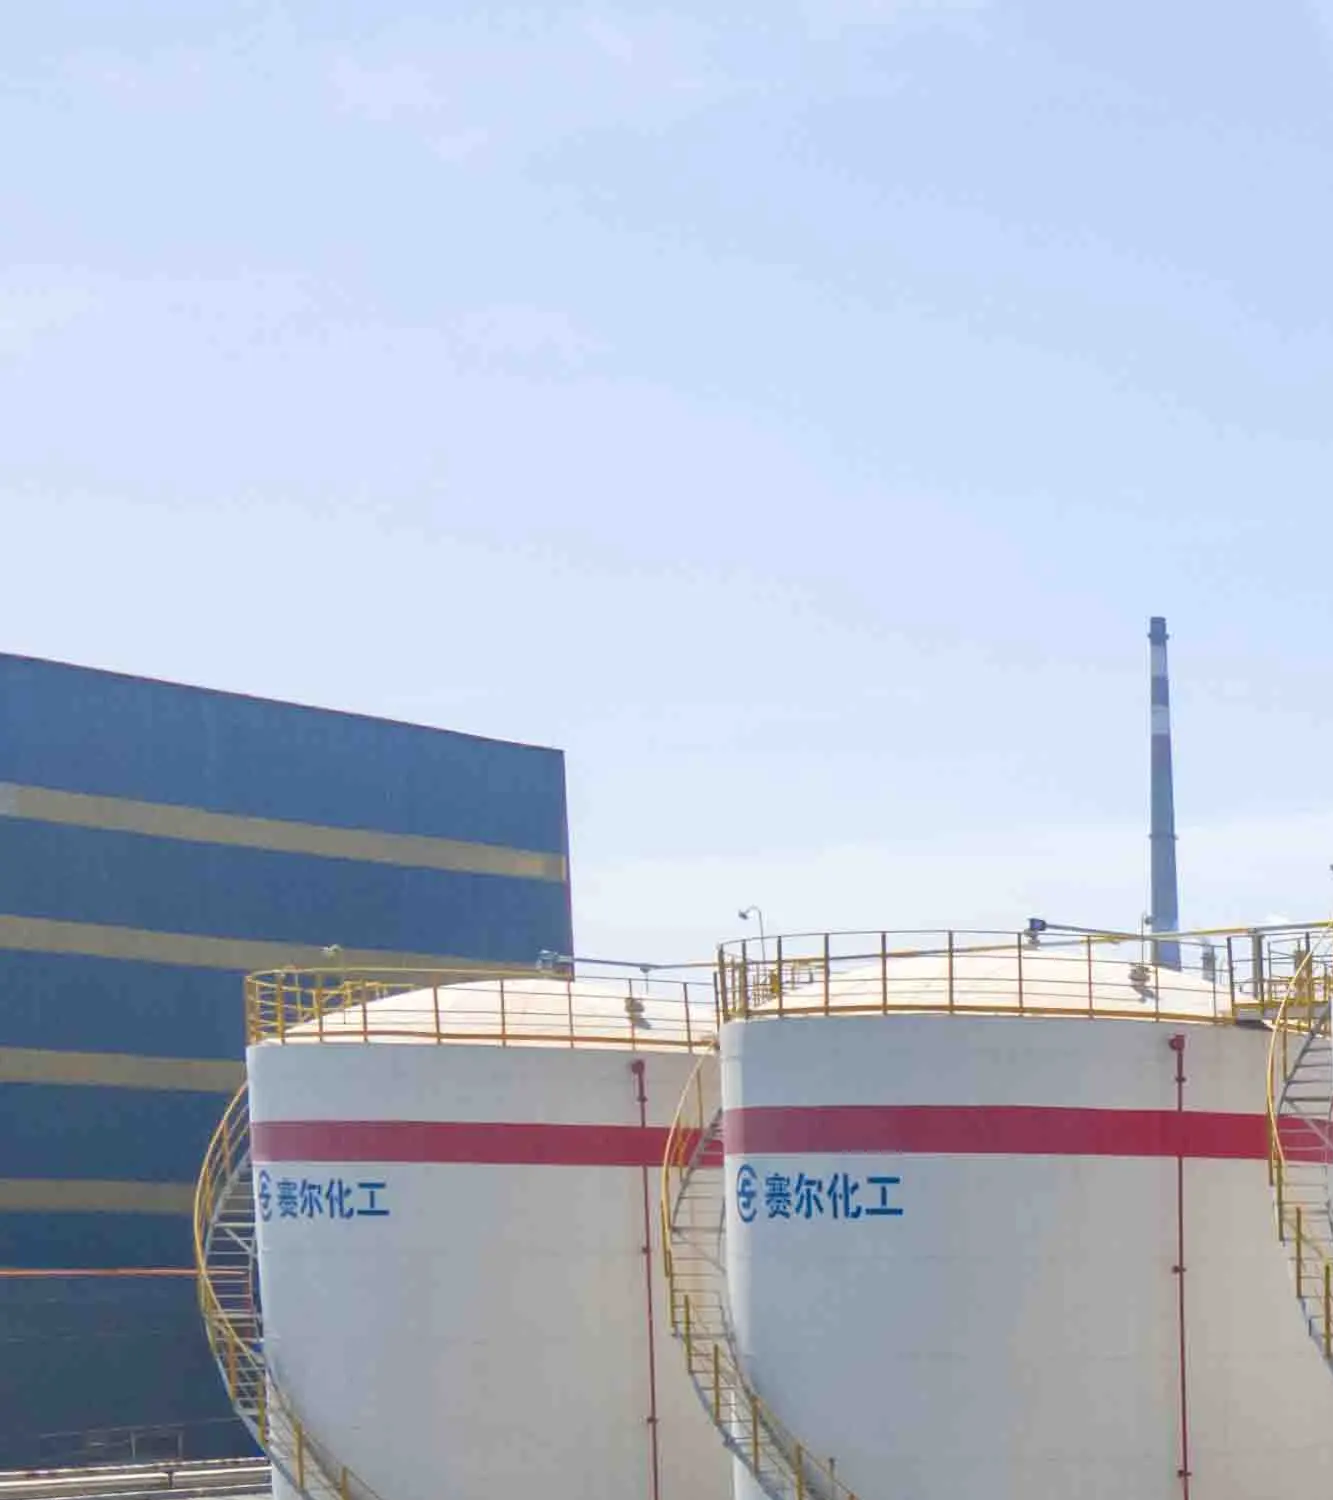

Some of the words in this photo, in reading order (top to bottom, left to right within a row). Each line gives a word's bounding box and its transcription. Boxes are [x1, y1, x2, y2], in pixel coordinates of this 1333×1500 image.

[277, 1178, 390, 1219] 赛尔化工
[765, 1172, 904, 1219] 赛尔化工
